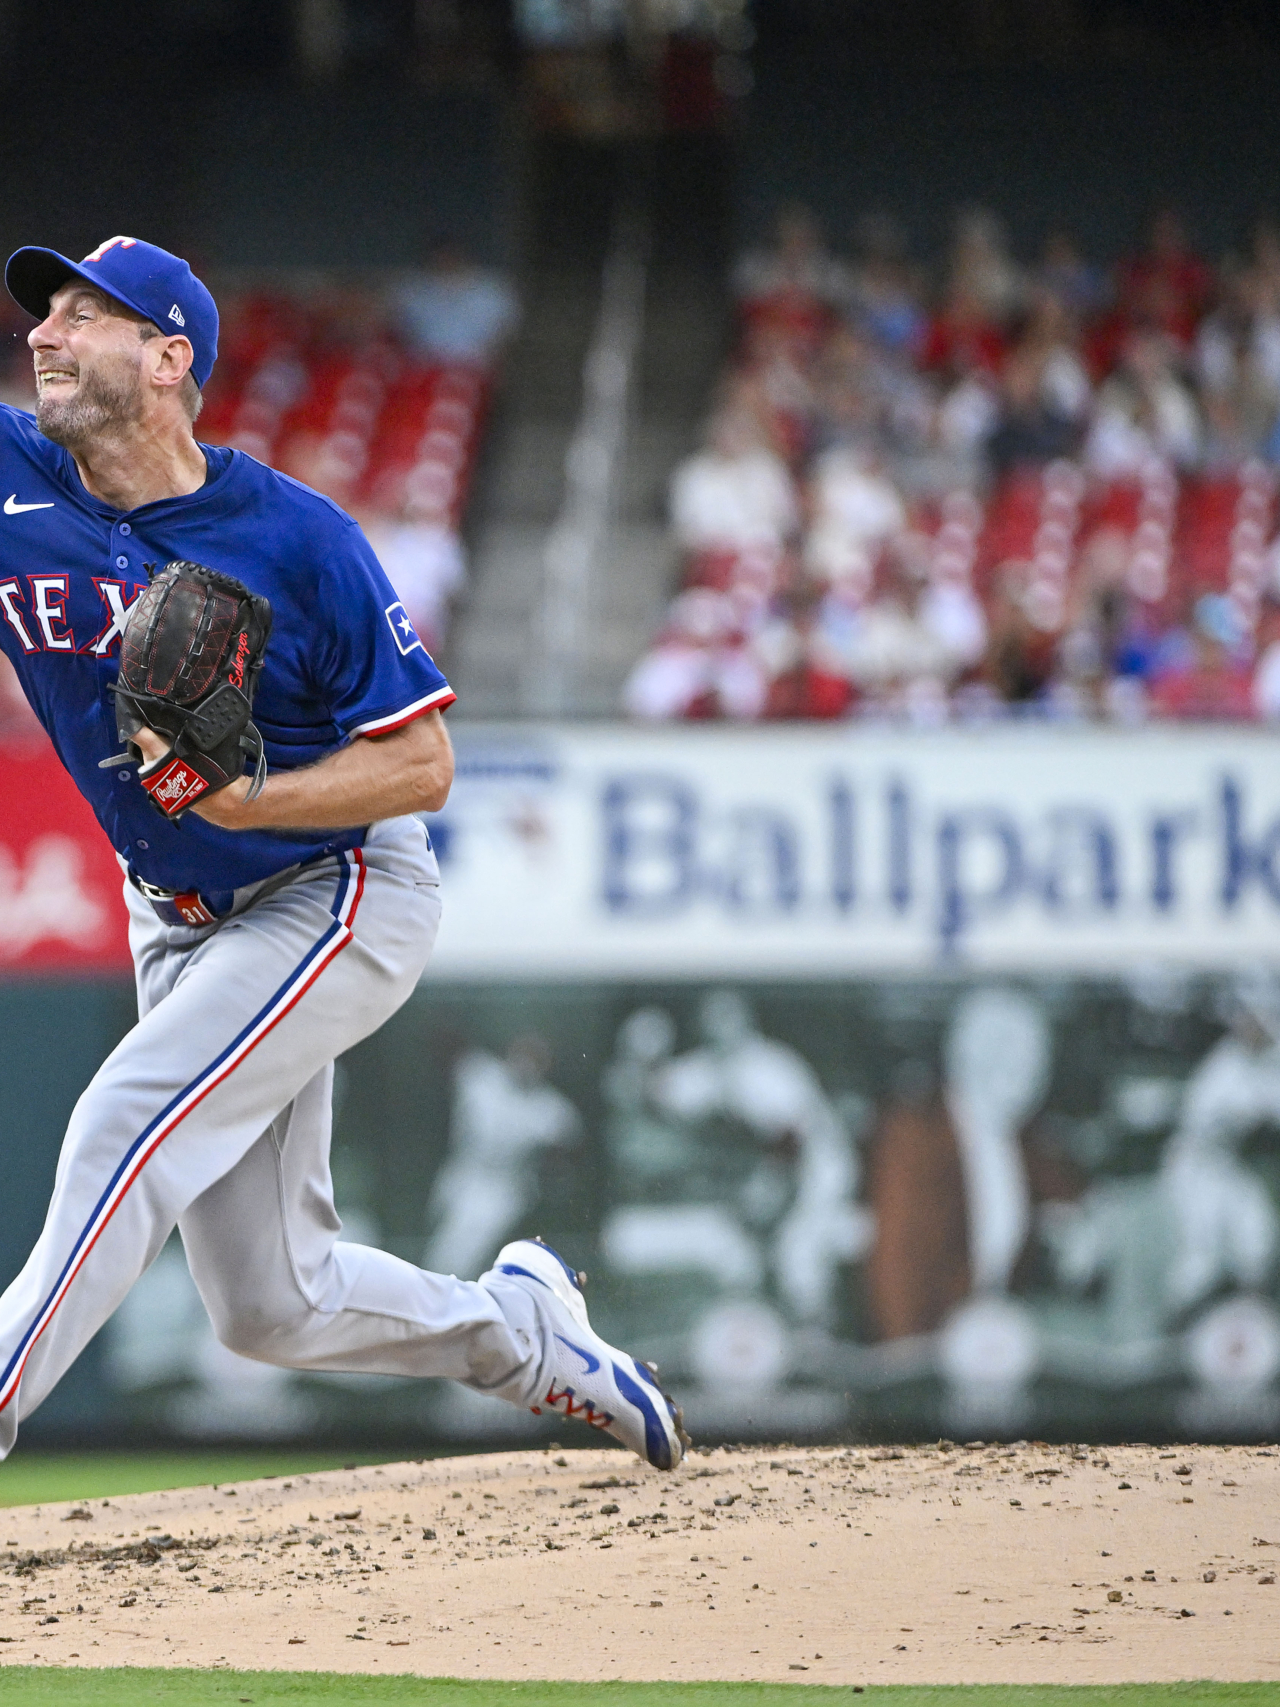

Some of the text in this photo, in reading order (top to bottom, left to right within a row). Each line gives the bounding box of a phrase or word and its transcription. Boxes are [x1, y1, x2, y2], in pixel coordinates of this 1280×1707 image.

[155, 770, 188, 802] Rawlings
[598, 768, 1280, 950] Ballpark
[181, 906, 206, 924] 31
